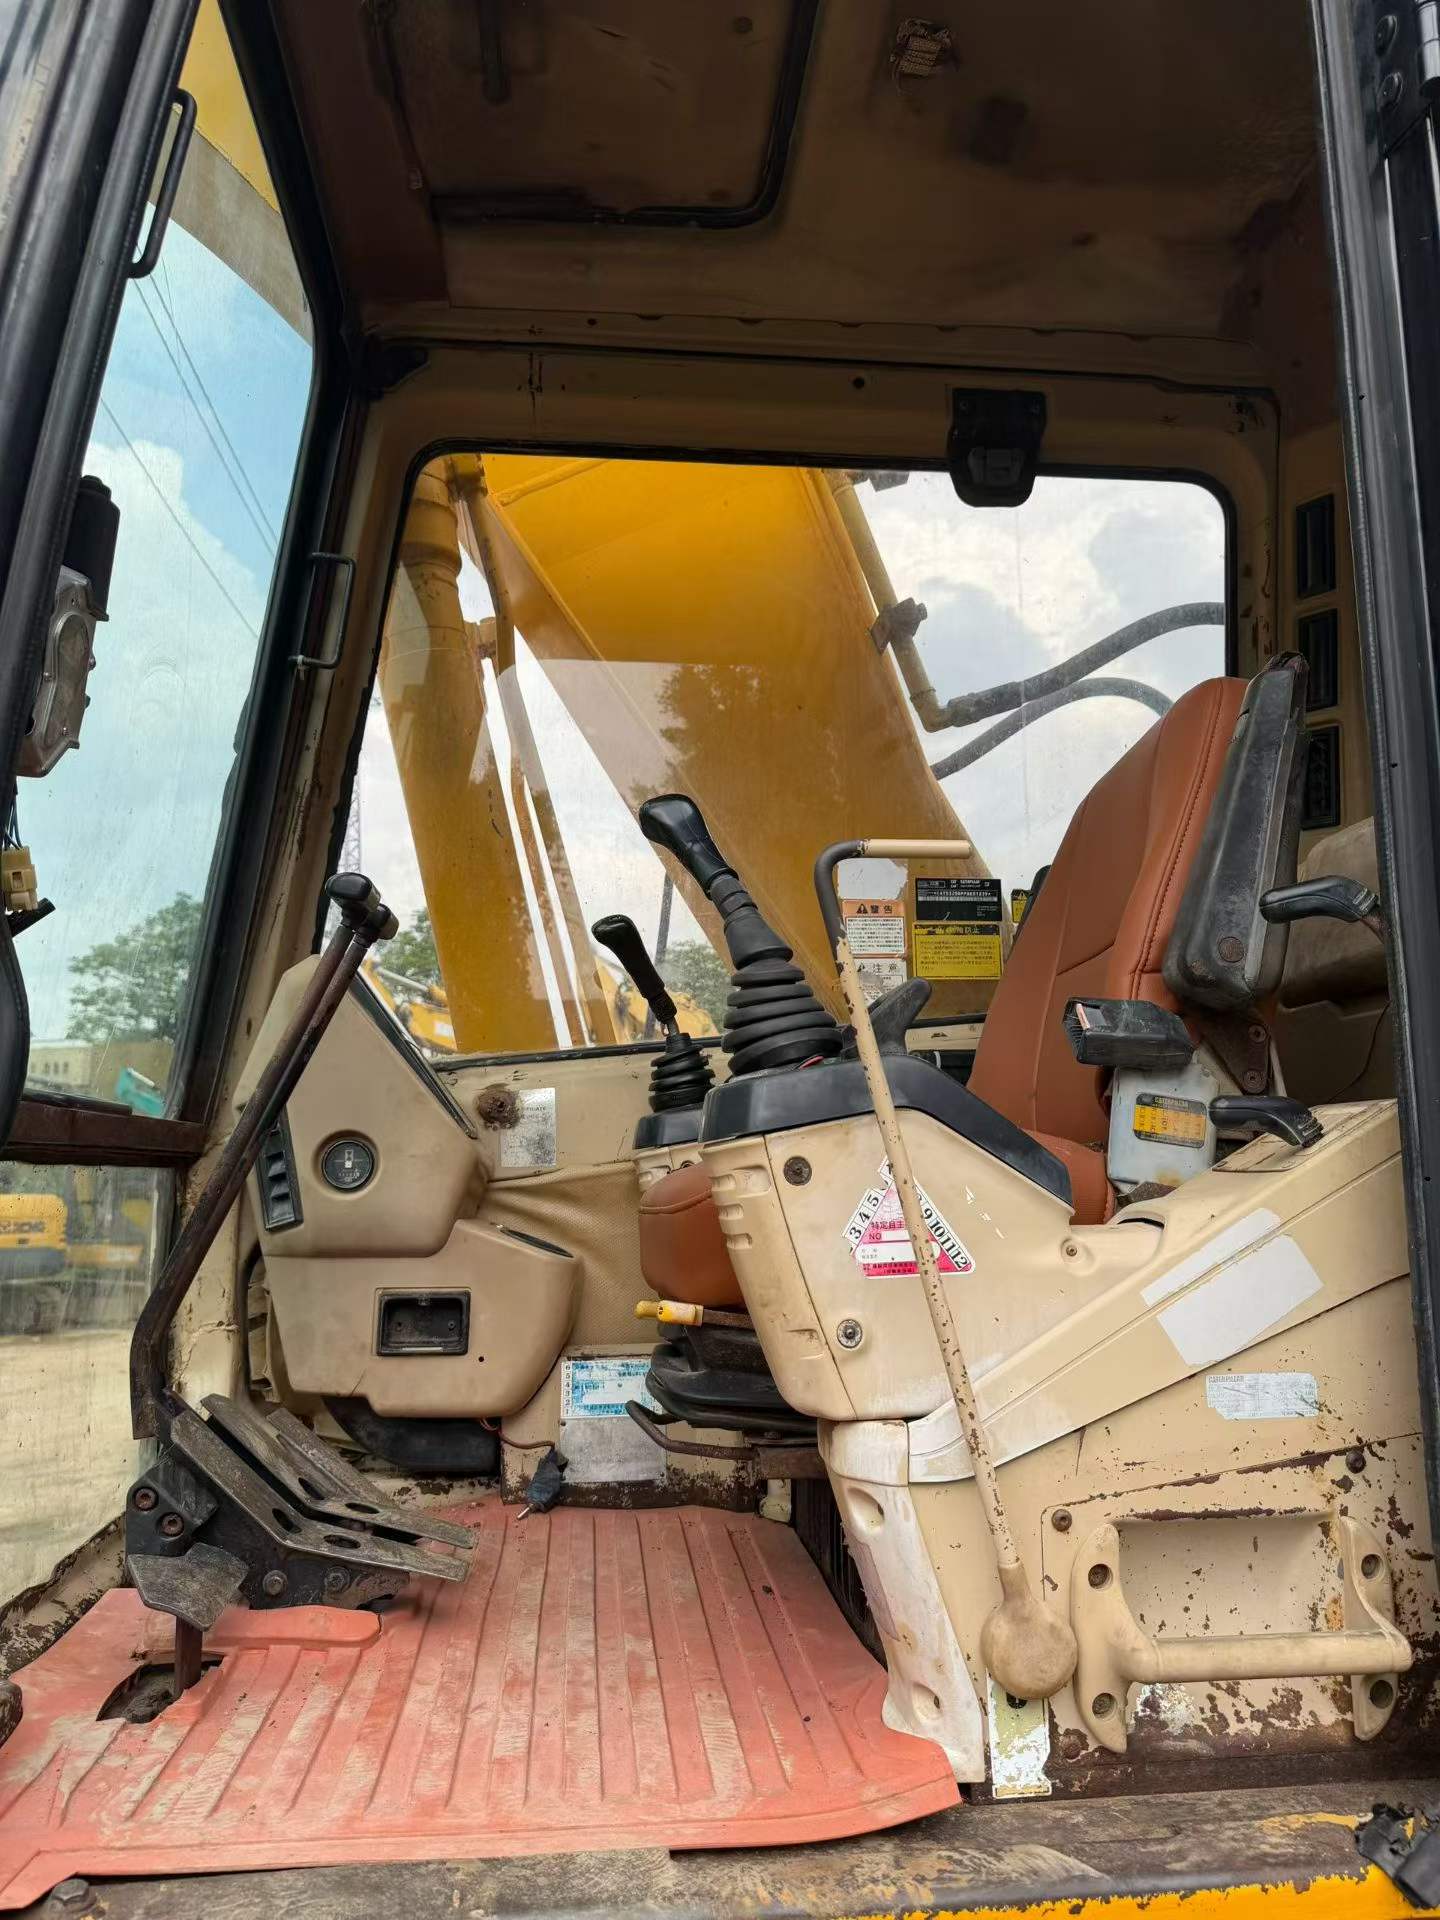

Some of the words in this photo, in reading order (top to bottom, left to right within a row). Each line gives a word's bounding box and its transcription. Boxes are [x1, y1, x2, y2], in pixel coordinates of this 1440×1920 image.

[849, 1227, 862, 1239] 3
[858, 1211, 871, 1223] 4
[867, 1194, 879, 1207] 5
[924, 1208, 933, 1220] 9
[929, 1219, 946, 1238] 10
[940, 1235, 957, 1252] 11
[951, 1249, 968, 1269] 12
